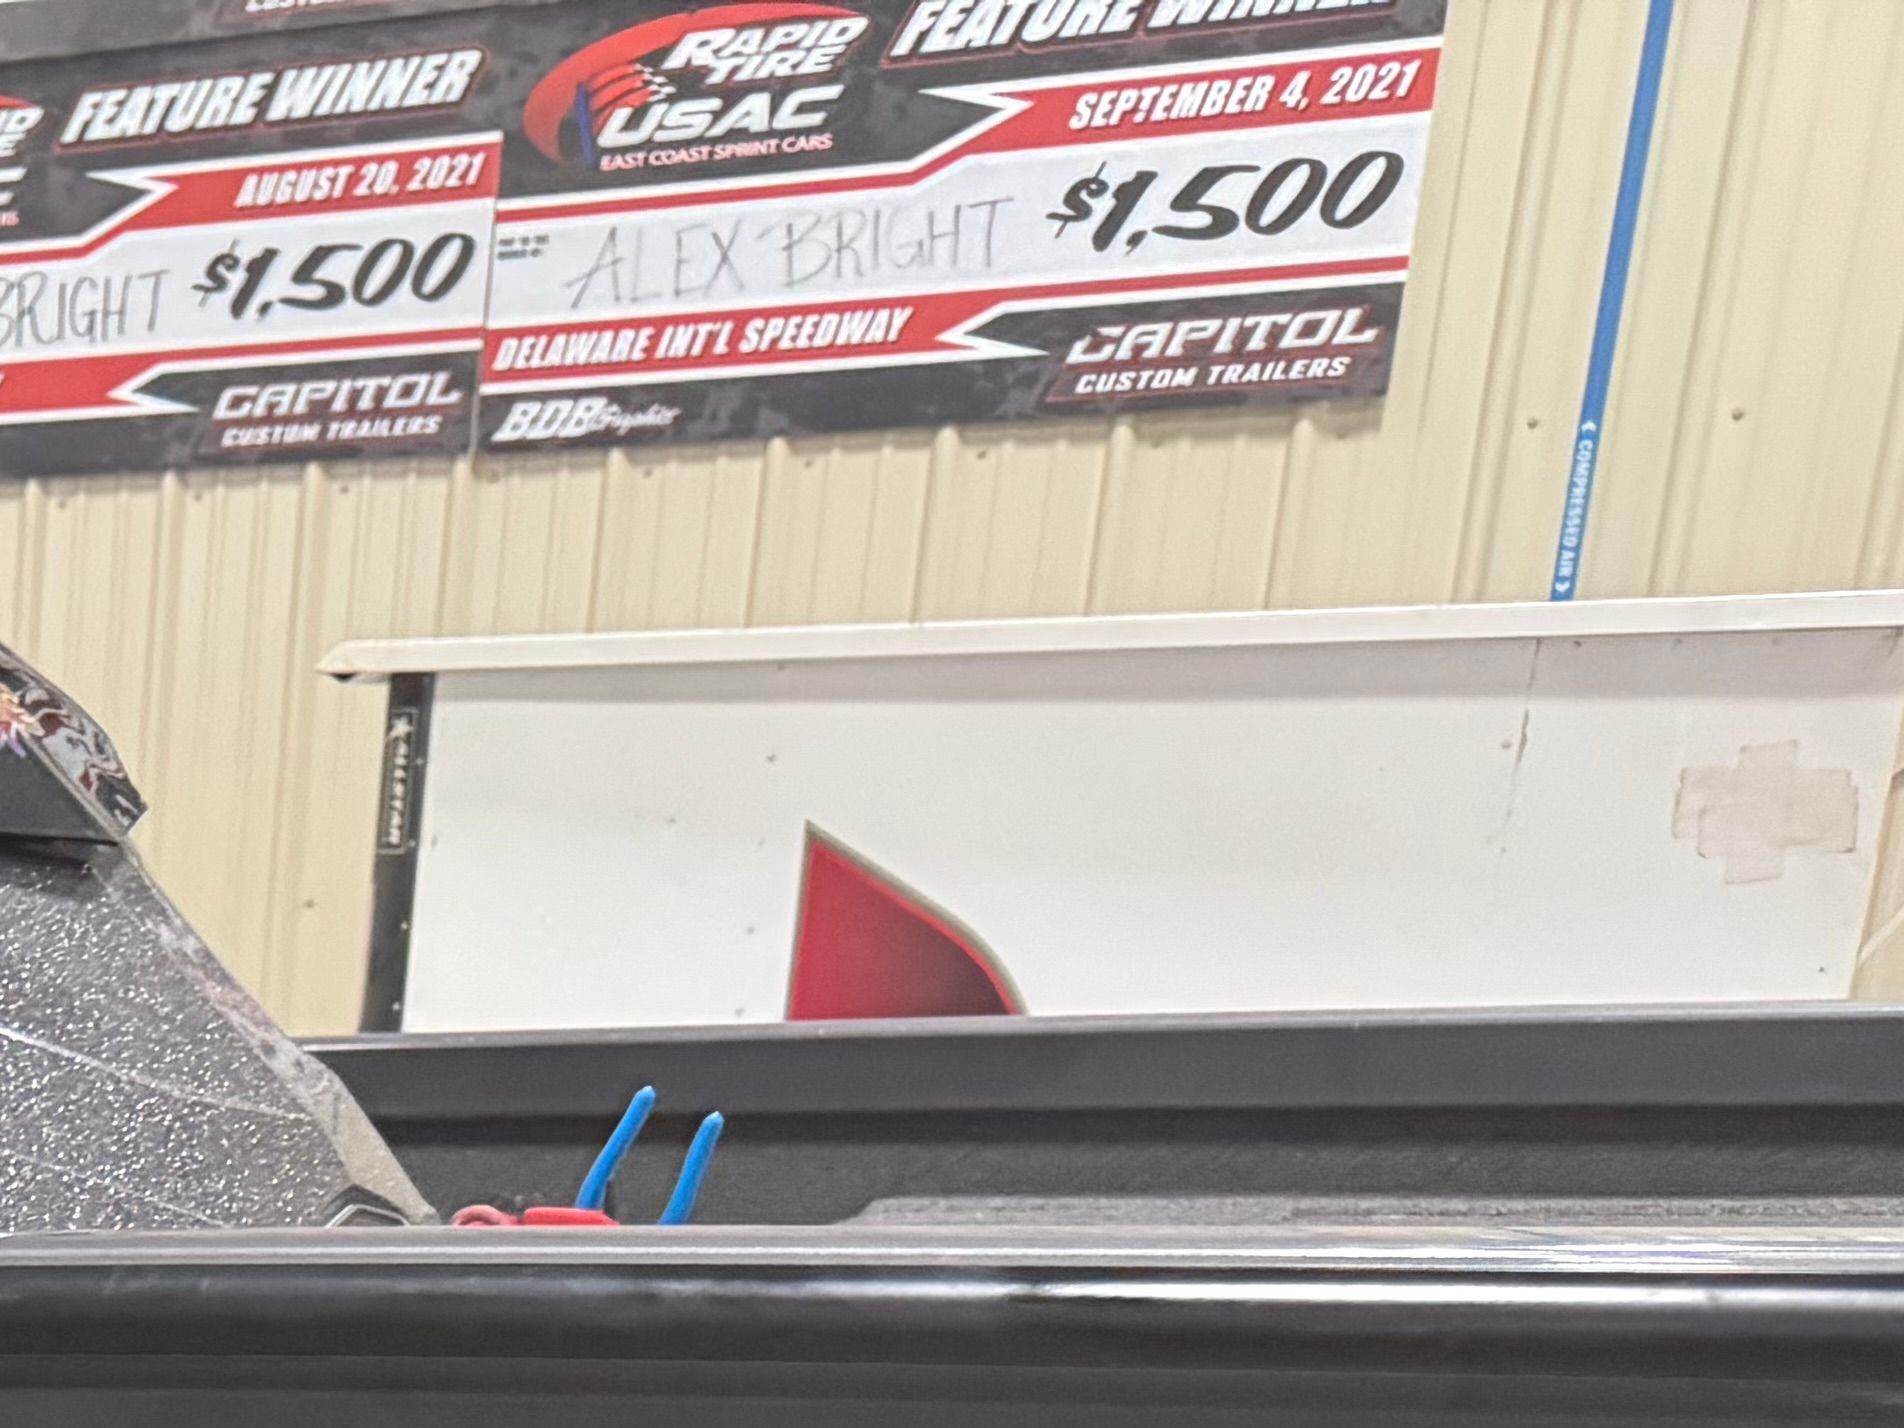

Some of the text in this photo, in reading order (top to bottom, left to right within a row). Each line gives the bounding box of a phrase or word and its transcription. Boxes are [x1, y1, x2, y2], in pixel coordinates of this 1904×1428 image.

[661, 16, 870, 70] RAPID
[889, 0, 1139, 57] FEATURE
[705, 44, 846, 85] TIRE
[60, 50, 483, 145] FEATURE WINNER
[596, 84, 845, 150] USAC
[1068, 60, 1421, 131] SEPTEMBER 4, 2021
[234, 164, 352, 209] AUGUST
[406, 152, 487, 192] 2021
[600, 133, 833, 171] EAST COAST SPRINT CARS
[1045, 150, 1405, 253] $1,500
[191, 232, 475, 320] $1,500
[564, 197, 1015, 310] ALEX BRIGHT
[493, 307, 914, 371] DELAWARE INT'L SPEEDWAY
[1064, 304, 1380, 365] CAPITOL
[212, 371, 463, 420] CAPITOL
[1073, 356, 1352, 394] CUSTOM TRAILERS
[221, 415, 443, 448] CUSTOM TRAILERS
[491, 396, 609, 443] BDB
[1559, 439, 1593, 576] COMPRESSED AIR
